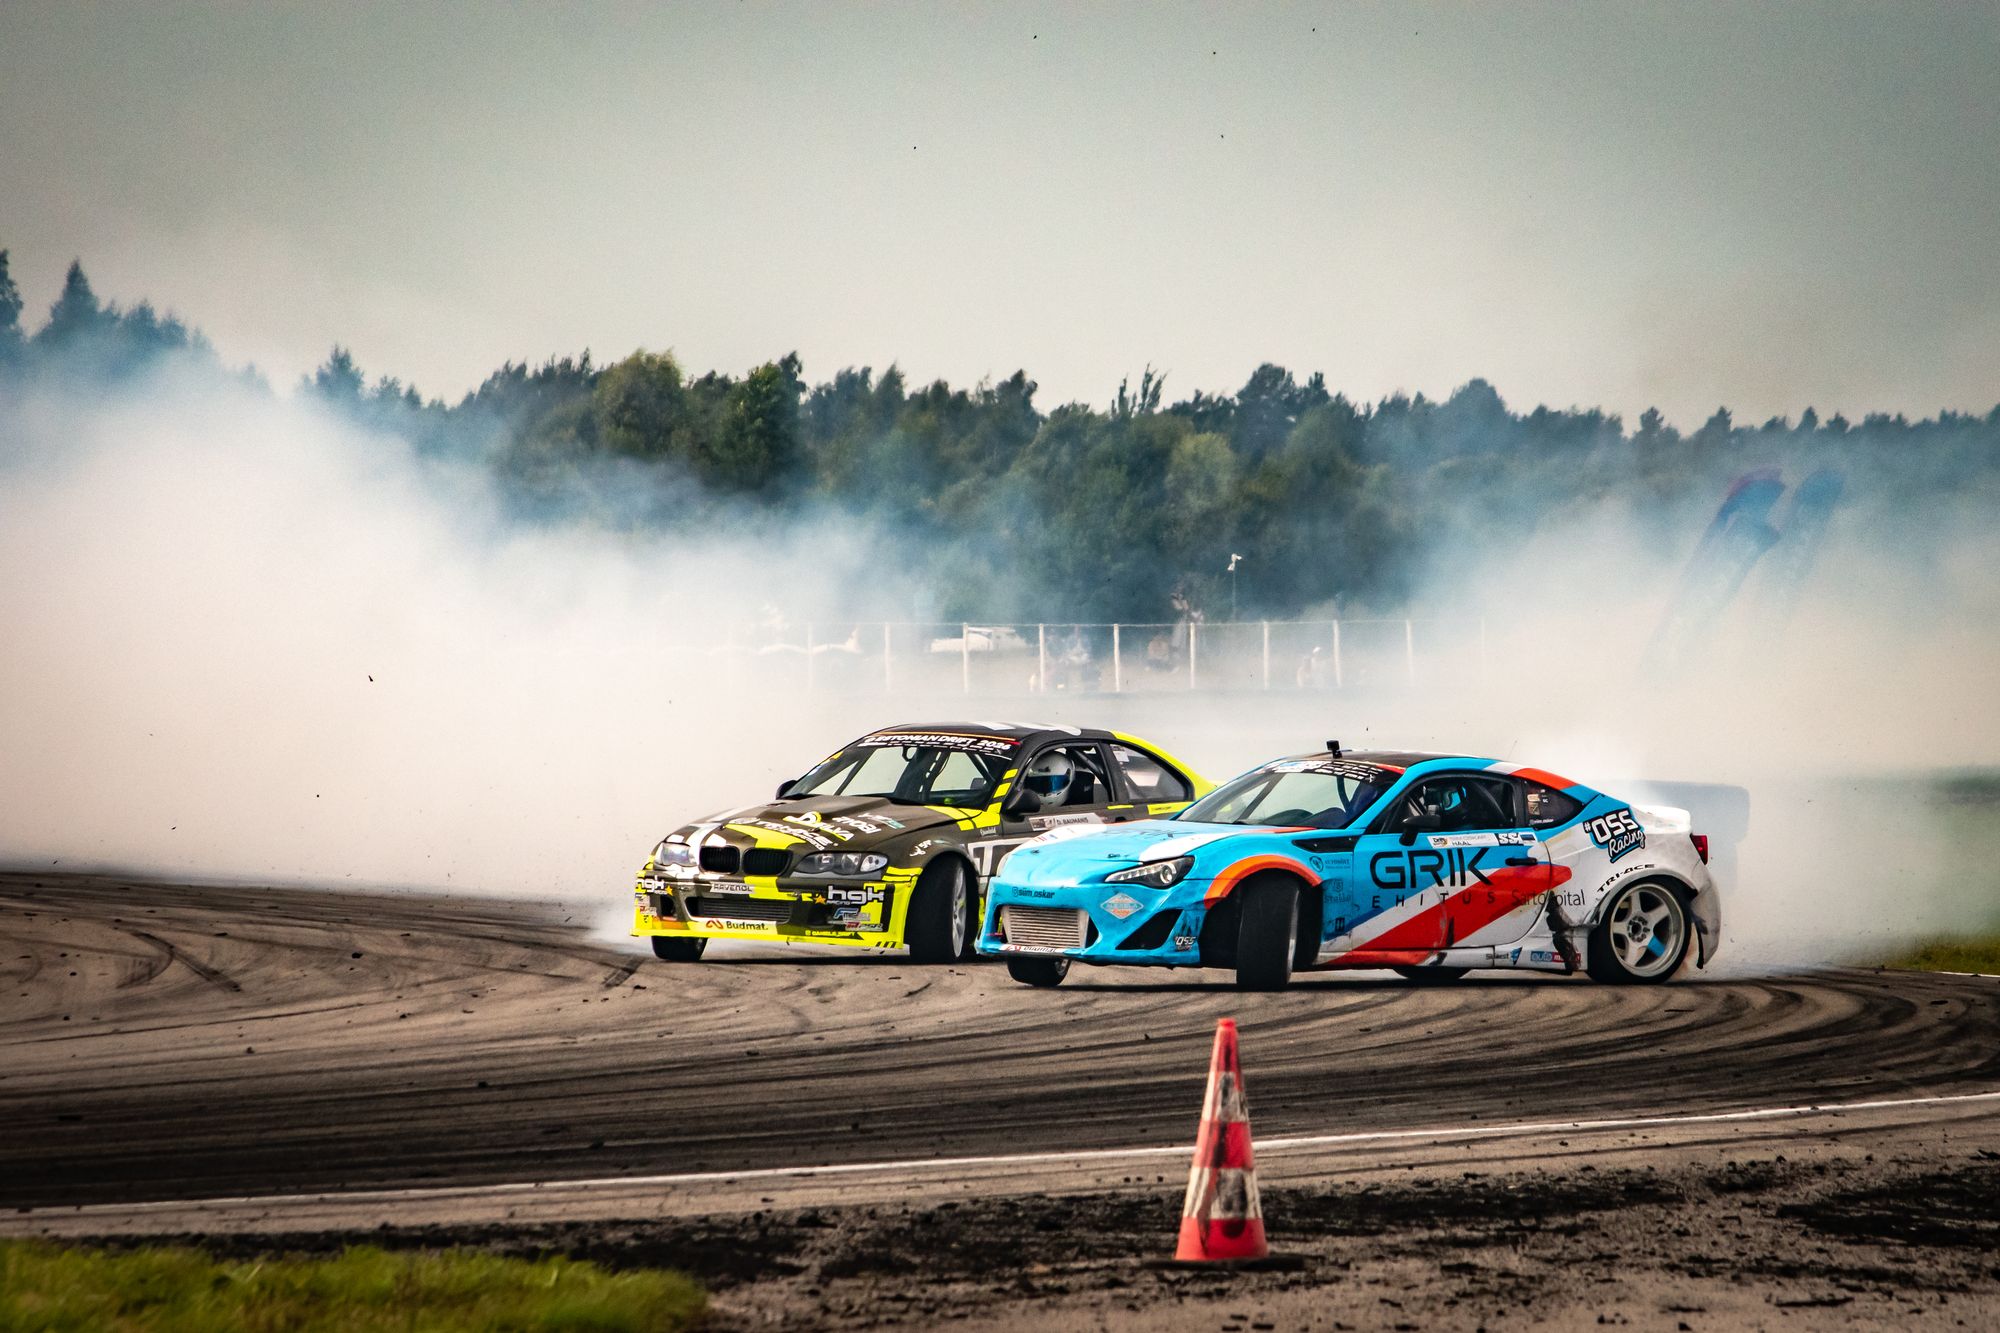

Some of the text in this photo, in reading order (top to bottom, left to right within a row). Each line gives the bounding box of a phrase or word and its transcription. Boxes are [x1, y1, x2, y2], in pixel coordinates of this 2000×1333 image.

[1609, 830, 1645, 857] Racing
[1369, 848, 1493, 890] GRIK
[1597, 864, 1655, 892] TRI-ACE
[827, 886, 884, 904] hgk
[1372, 891, 1496, 908] EHITUS
[726, 920, 769, 931] Budmat.
